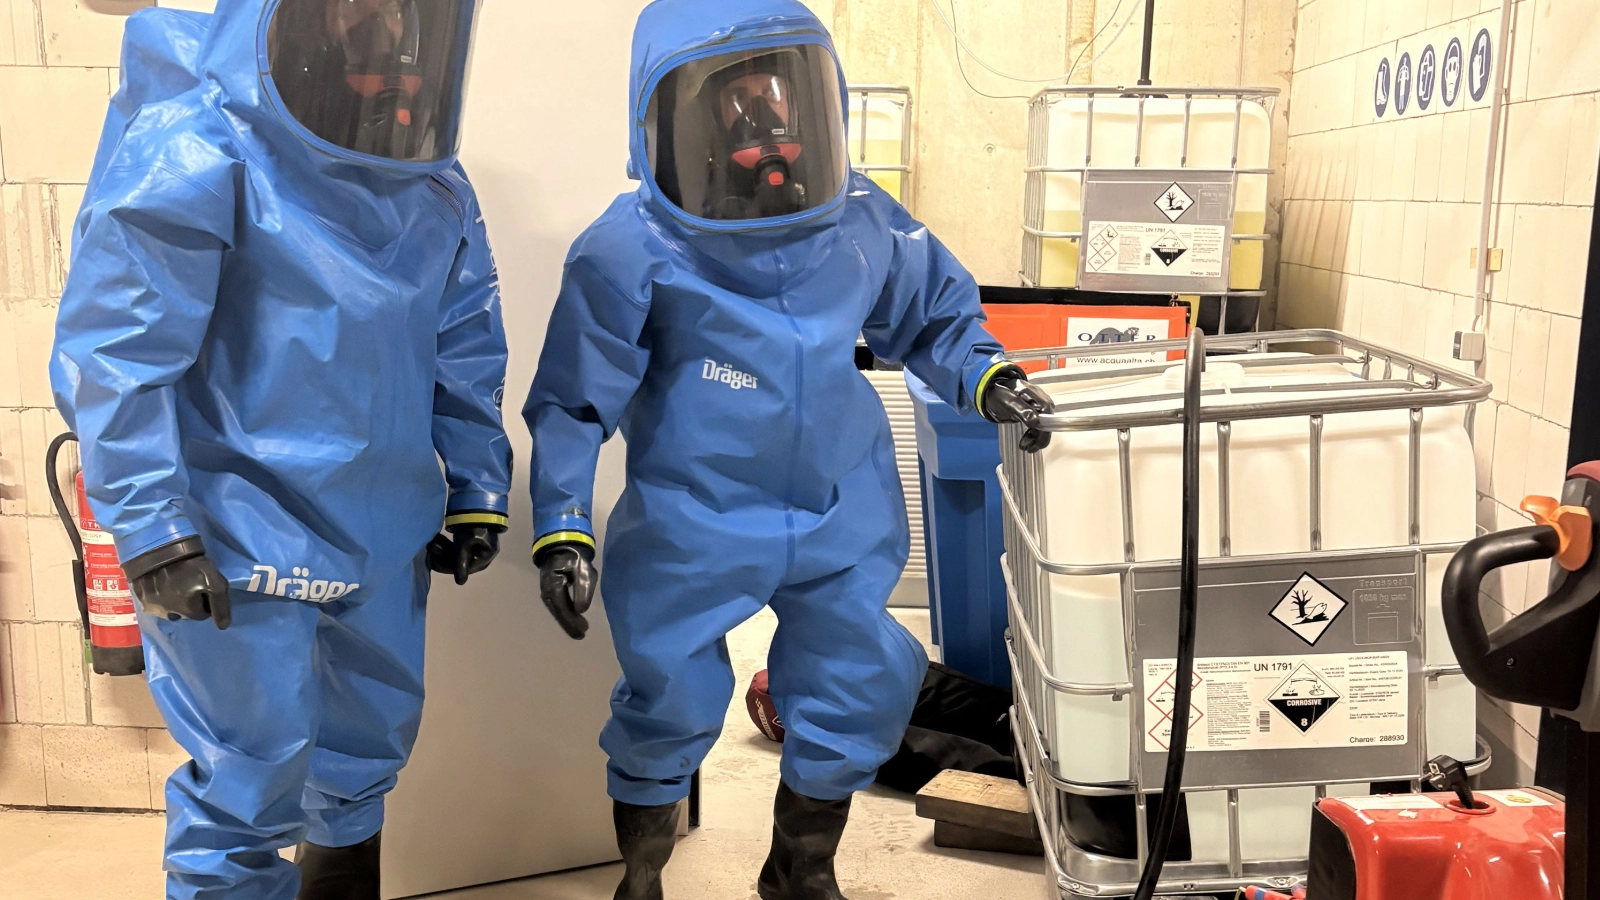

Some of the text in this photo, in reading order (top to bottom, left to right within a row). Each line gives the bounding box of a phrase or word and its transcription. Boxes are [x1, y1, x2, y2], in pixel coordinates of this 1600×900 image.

[702, 358, 758, 390] Dräger
[246, 564, 360, 604] Dräger
[1254, 662, 1292, 672] UN 1791
[1286, 698, 1322, 706] CORROSIVE
[1300, 718, 1308, 726] 8
